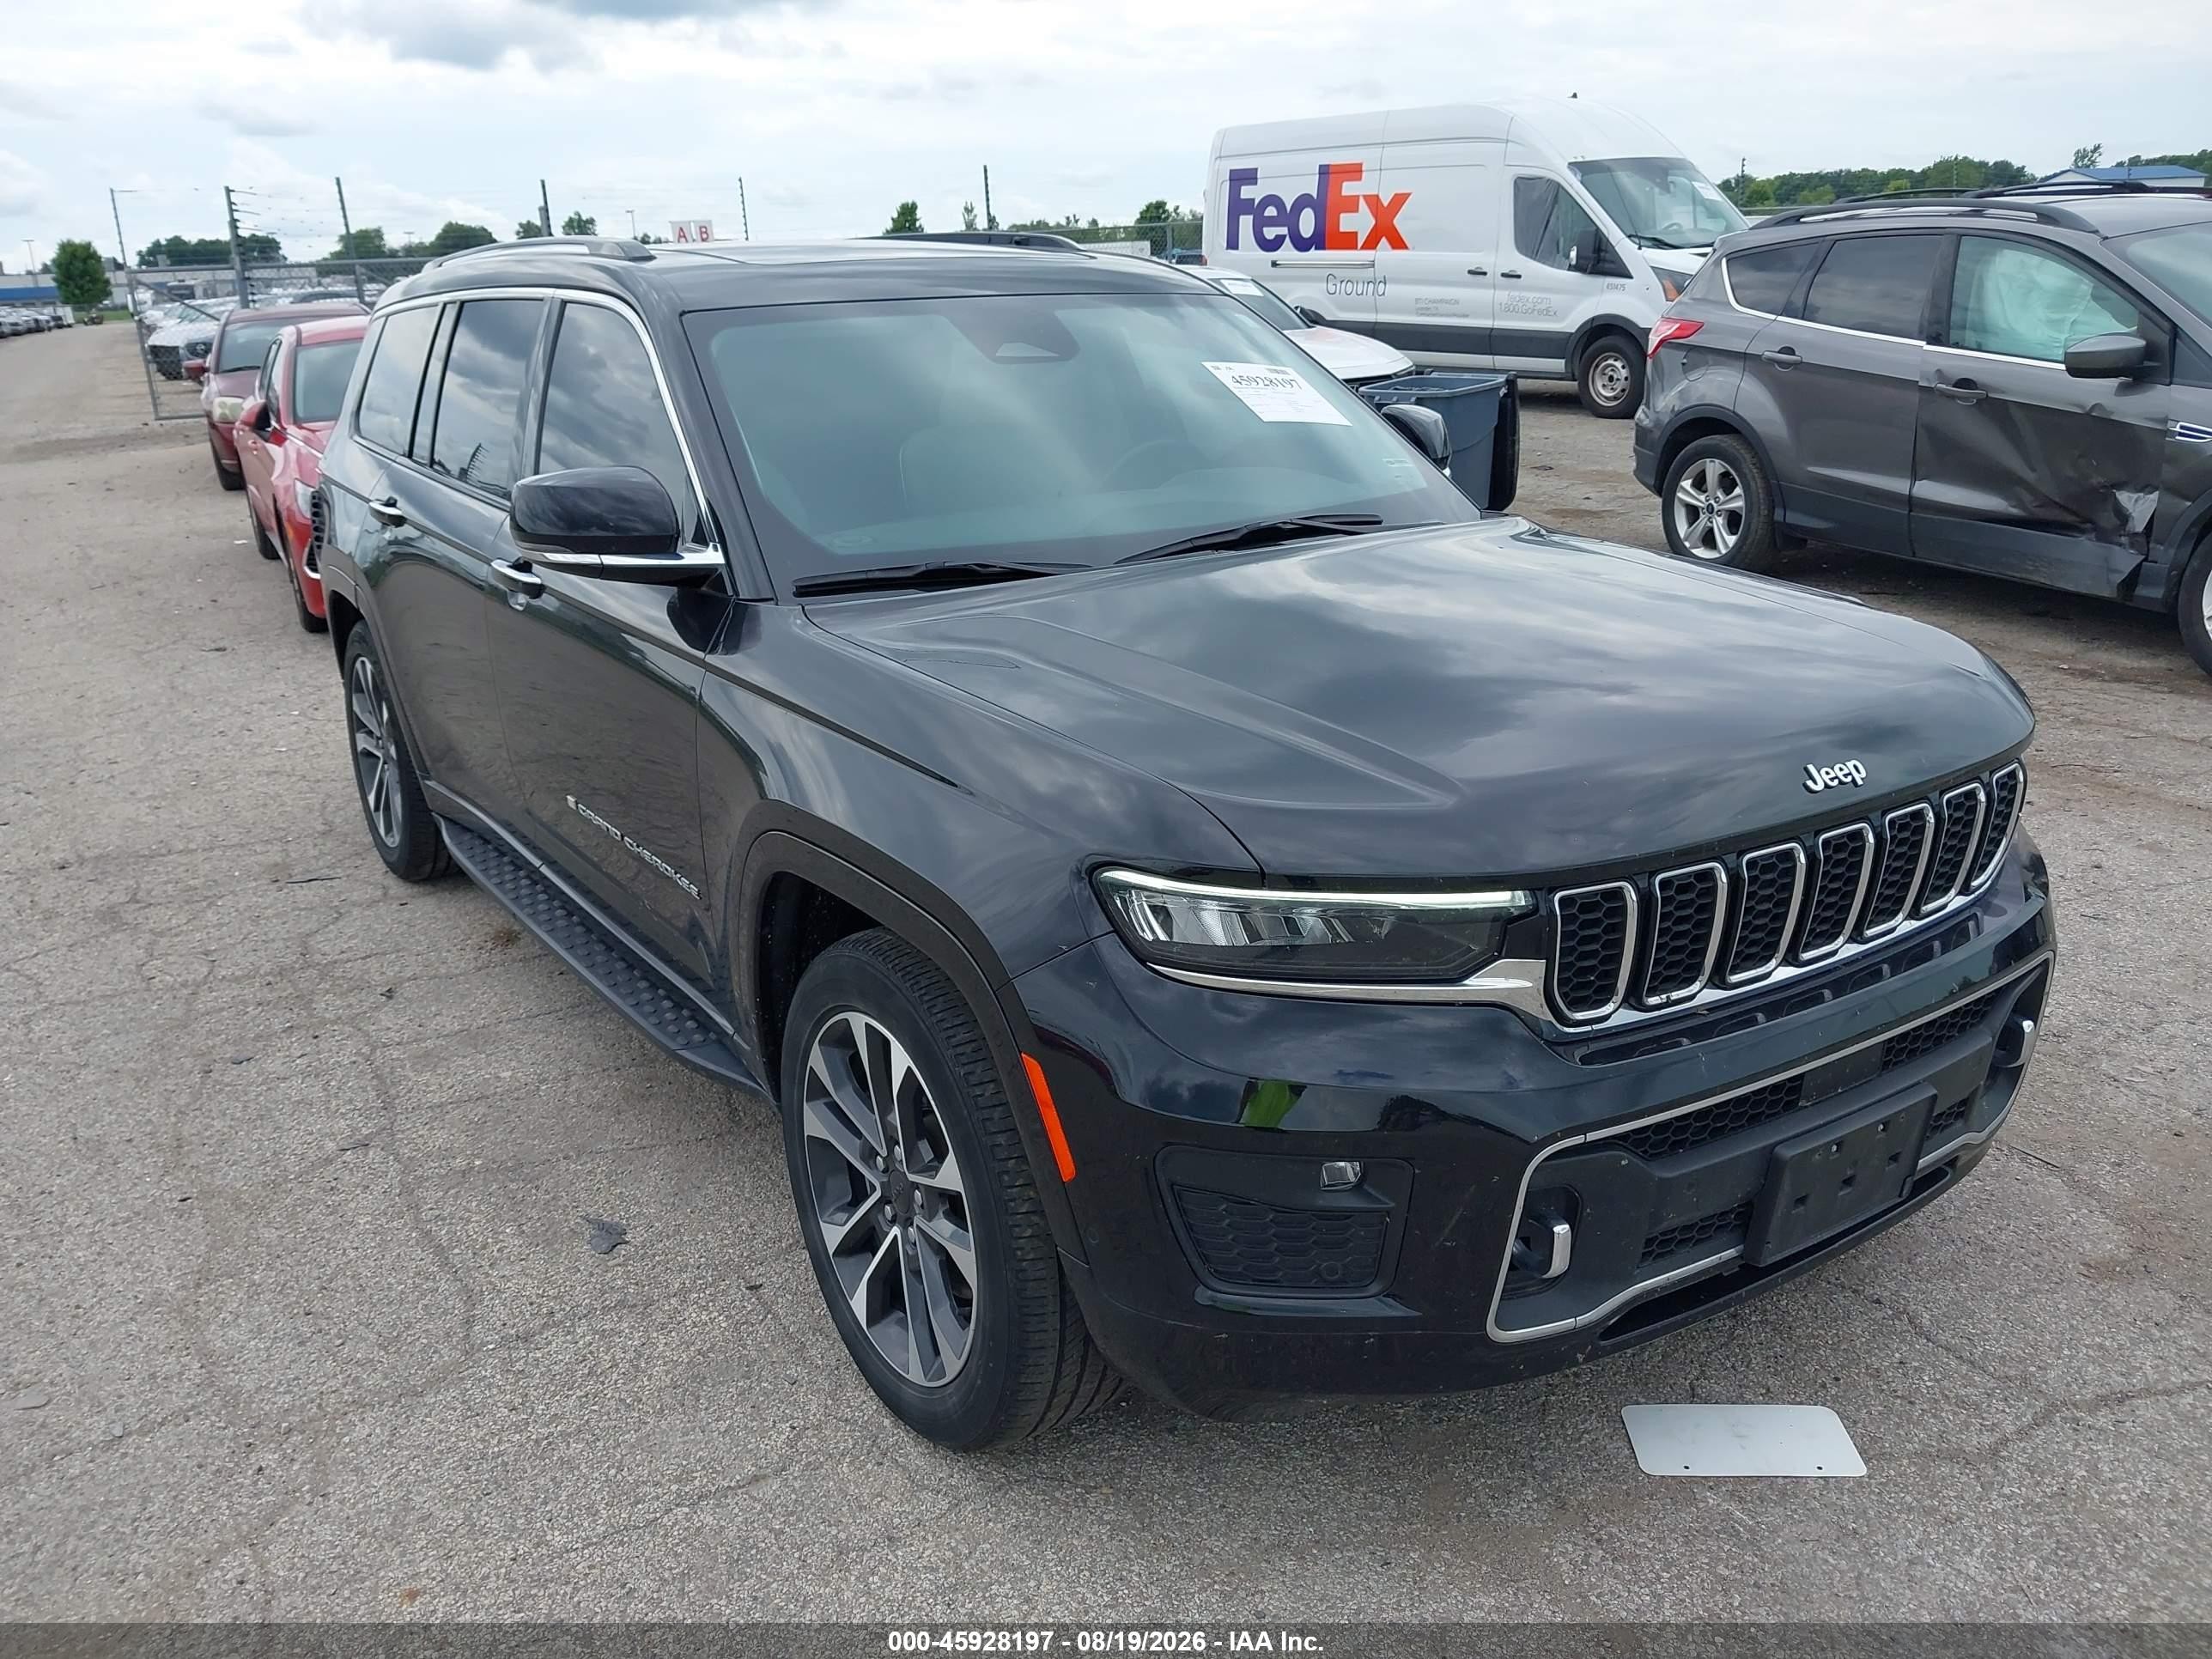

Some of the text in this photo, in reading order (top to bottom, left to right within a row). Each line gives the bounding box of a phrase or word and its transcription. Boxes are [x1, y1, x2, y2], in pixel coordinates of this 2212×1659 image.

[1226, 162, 1412, 252] FedEx
[678, 226, 709, 243] A B
[1326, 273, 1387, 297] Ground
[1231, 375, 1303, 390] 45928197
[1803, 759, 1867, 793] Jeep
